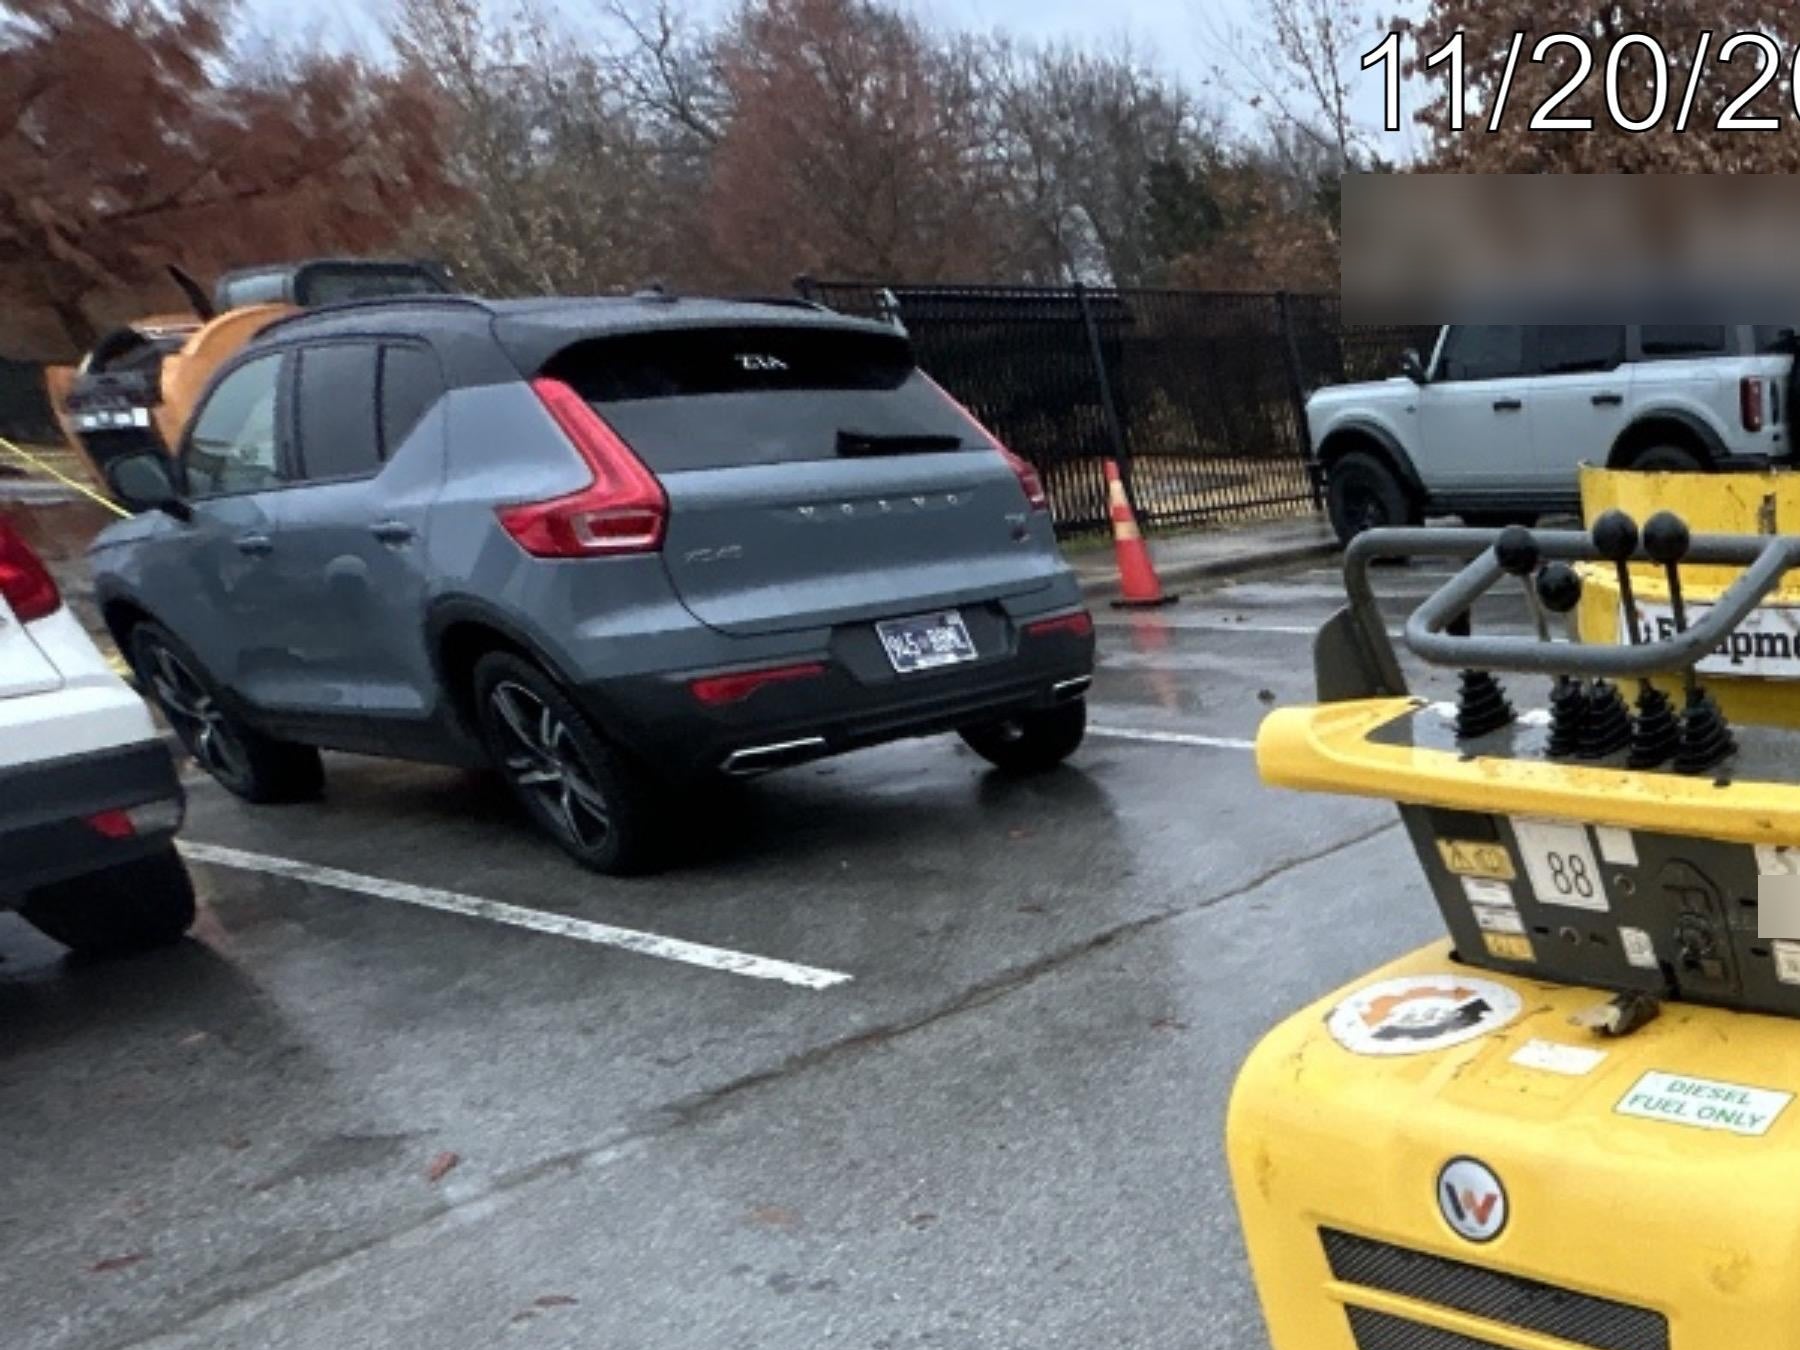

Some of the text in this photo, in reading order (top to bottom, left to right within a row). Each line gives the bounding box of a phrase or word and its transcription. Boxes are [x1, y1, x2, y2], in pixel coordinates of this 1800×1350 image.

[1547, 851, 1594, 898] 88
[1666, 1079, 1752, 1105] DIESEL
[1628, 1093, 1767, 1128] FUEL ONLY
